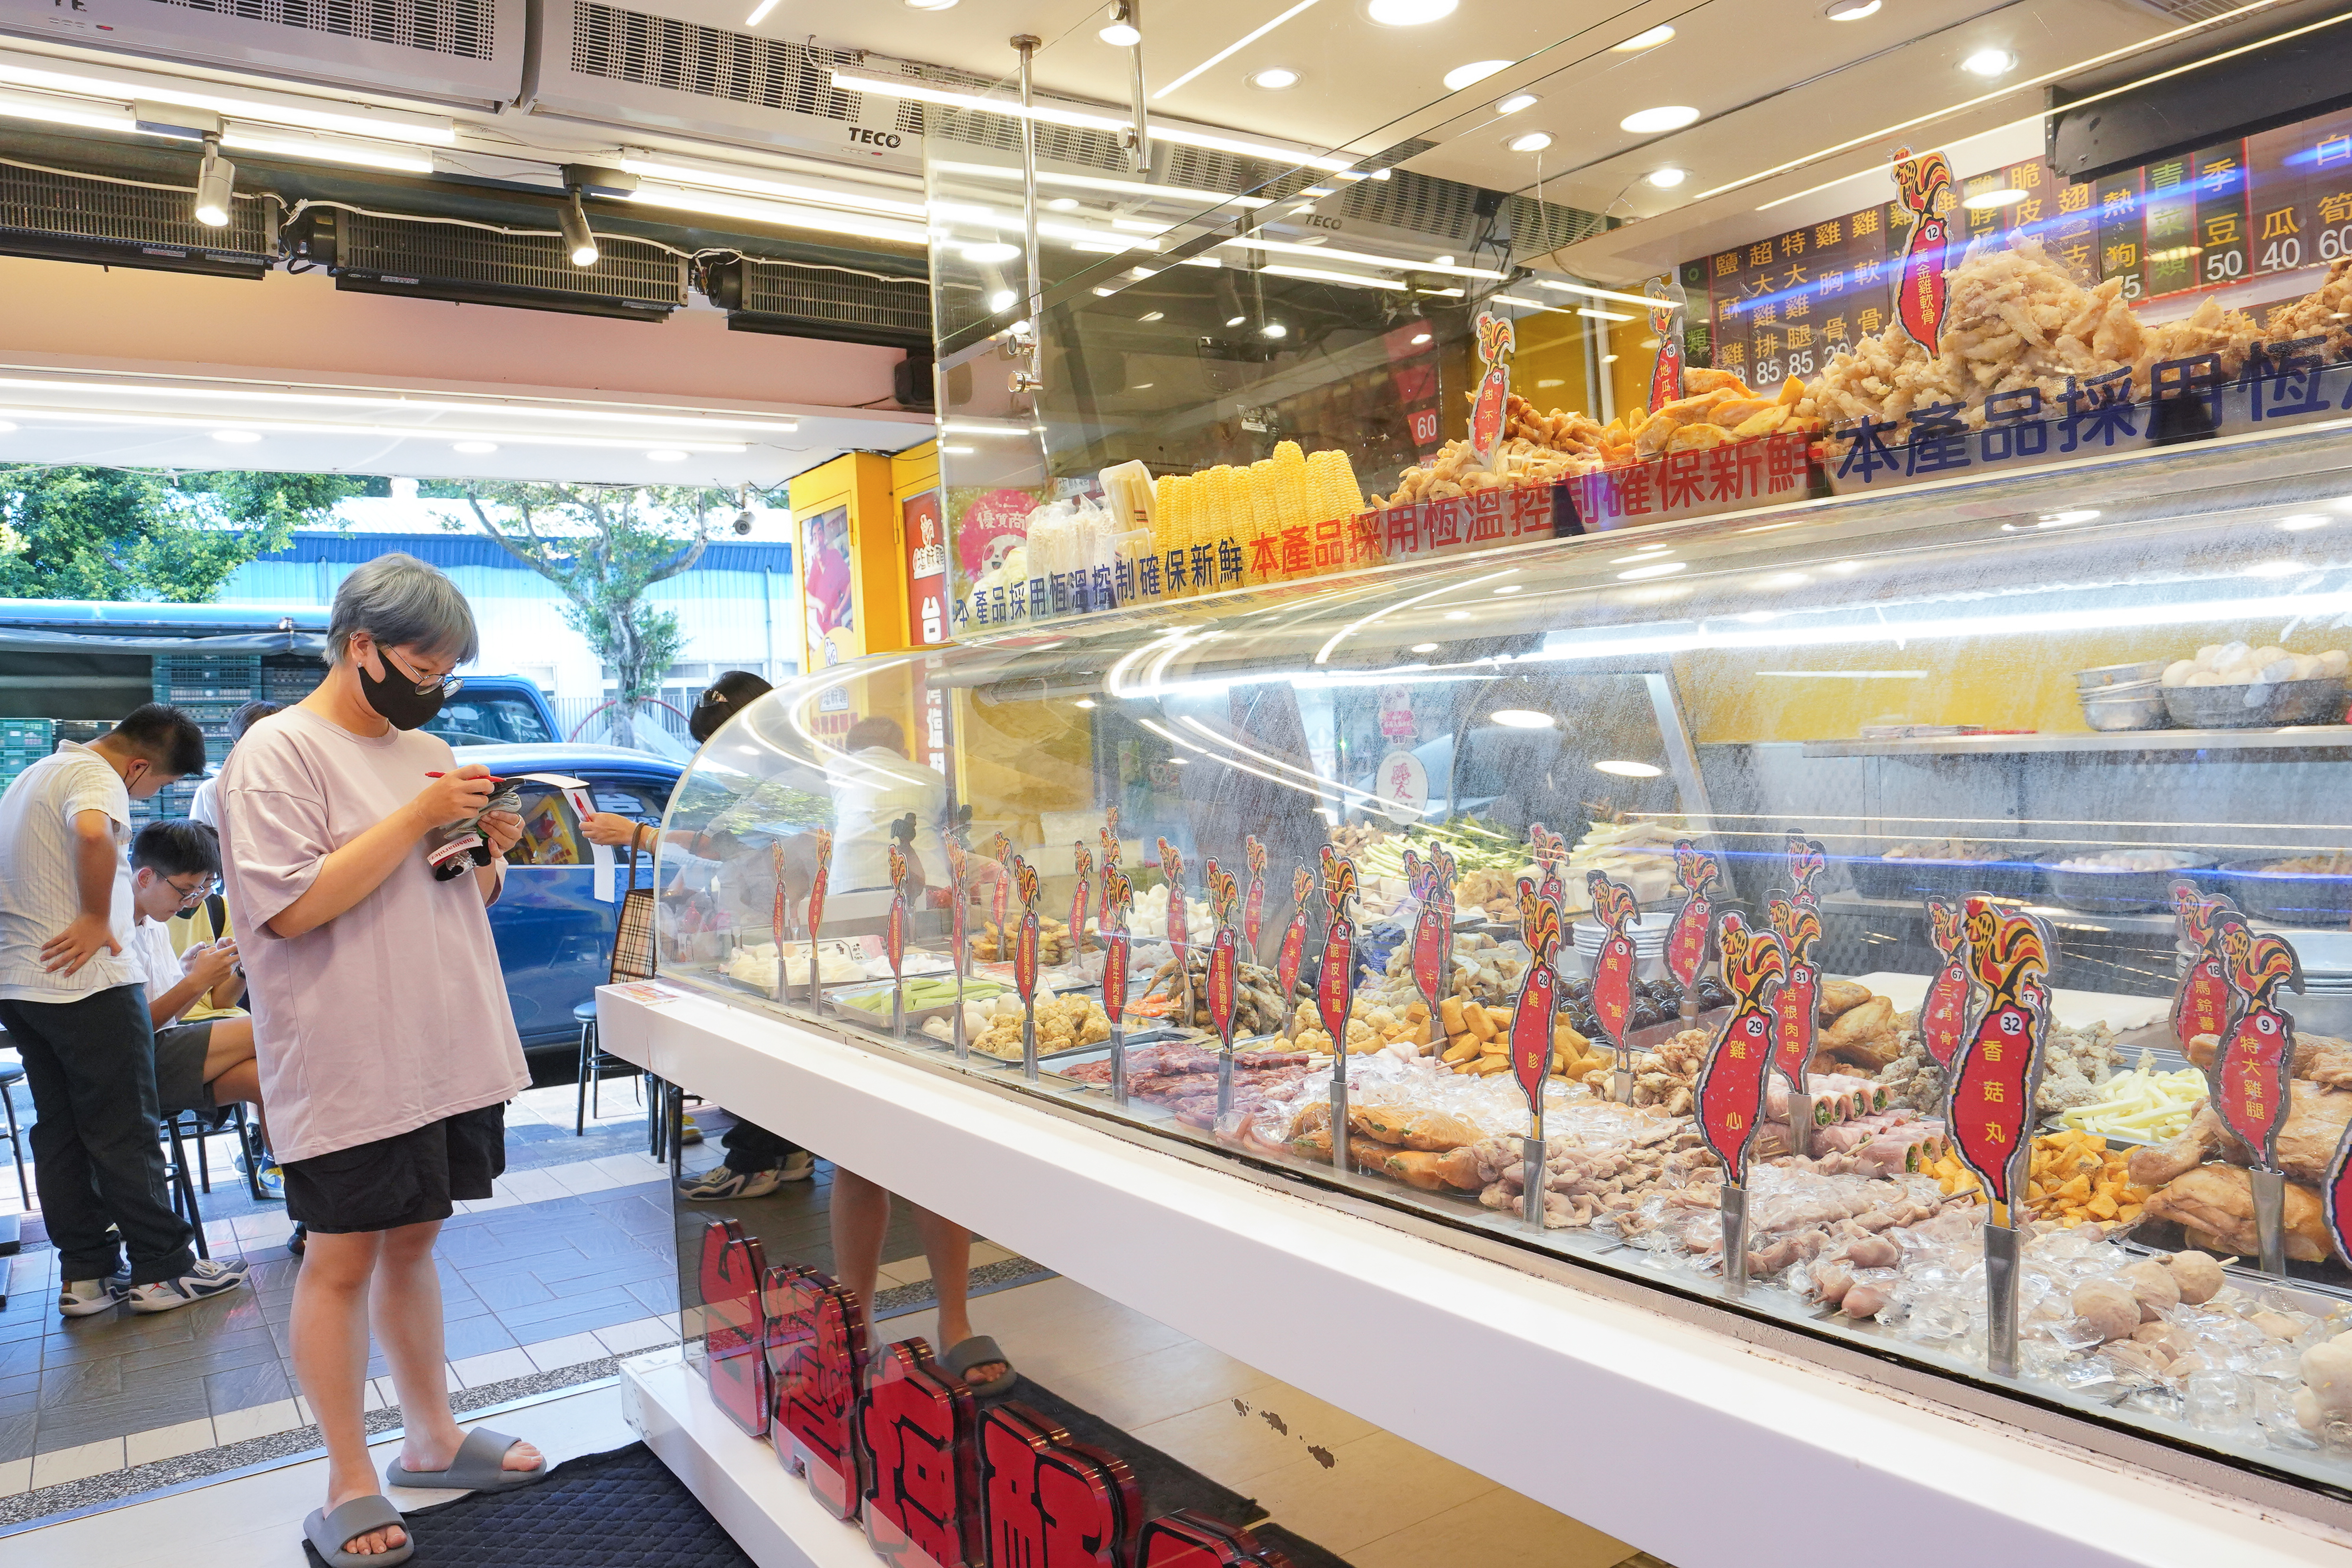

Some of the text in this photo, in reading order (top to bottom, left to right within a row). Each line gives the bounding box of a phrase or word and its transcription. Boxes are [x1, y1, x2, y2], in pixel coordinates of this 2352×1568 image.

[849, 127, 901, 148] TECO
[1306, 214, 1342, 230] TECO
[1927, 227, 1938, 239] 12
[2103, 188, 2136, 269] 熱狗
[2261, 238, 2300, 270] 40
[2319, 225, 2352, 259] 60
[1852, 210, 1882, 332] 雞軟骨
[2207, 250, 2242, 279] 50
[1782, 231, 1812, 350] 特大雞腿
[1816, 221, 1847, 342] 雞胸骨
[1915, 248, 1935, 325] 黃金雞軟骨
[1716, 252, 1744, 366] 鹽酥雞
[1749, 241, 1779, 359] 超大雞排
[1667, 347, 1674, 356] 19
[1789, 350, 1814, 376] 85
[1493, 374, 1501, 383] 14
[1756, 361, 1780, 384] 85
[1484, 389, 1494, 443] 甜不辣
[1836, 325, 2352, 483] 本產品採用恆
[1418, 414, 1436, 438] 60
[1250, 422, 1823, 577] 本產品採用恆溫控制確保新鮮
[1696, 905, 1705, 913] 13
[1119, 933, 1124, 941] 49
[1224, 933, 1231, 944] 51
[1339, 928, 1346, 937] 34
[1422, 929, 1434, 984] 豆干
[2208, 964, 2219, 976] 18
[1329, 943, 1342, 1013] 脆皮肥腸
[1539, 975, 1548, 985] 28
[1796, 971, 1807, 982] 31
[1952, 970, 1963, 979] 67
[1783, 989, 1799, 1054] 培根肉串
[1939, 983, 1953, 1046] 三角骨
[2194, 980, 2215, 1032] 馬鈴薯
[1748, 1021, 1763, 1034] 29
[2003, 1016, 2021, 1032] 32
[2262, 1019, 2270, 1032] 9
[1726, 1040, 1747, 1130] 雞心
[1982, 1040, 2006, 1143] 香菇丸
[2240, 1036, 2265, 1121] 特大雞腿
[698, 1218, 1289, 1568] 台灣塩酥
